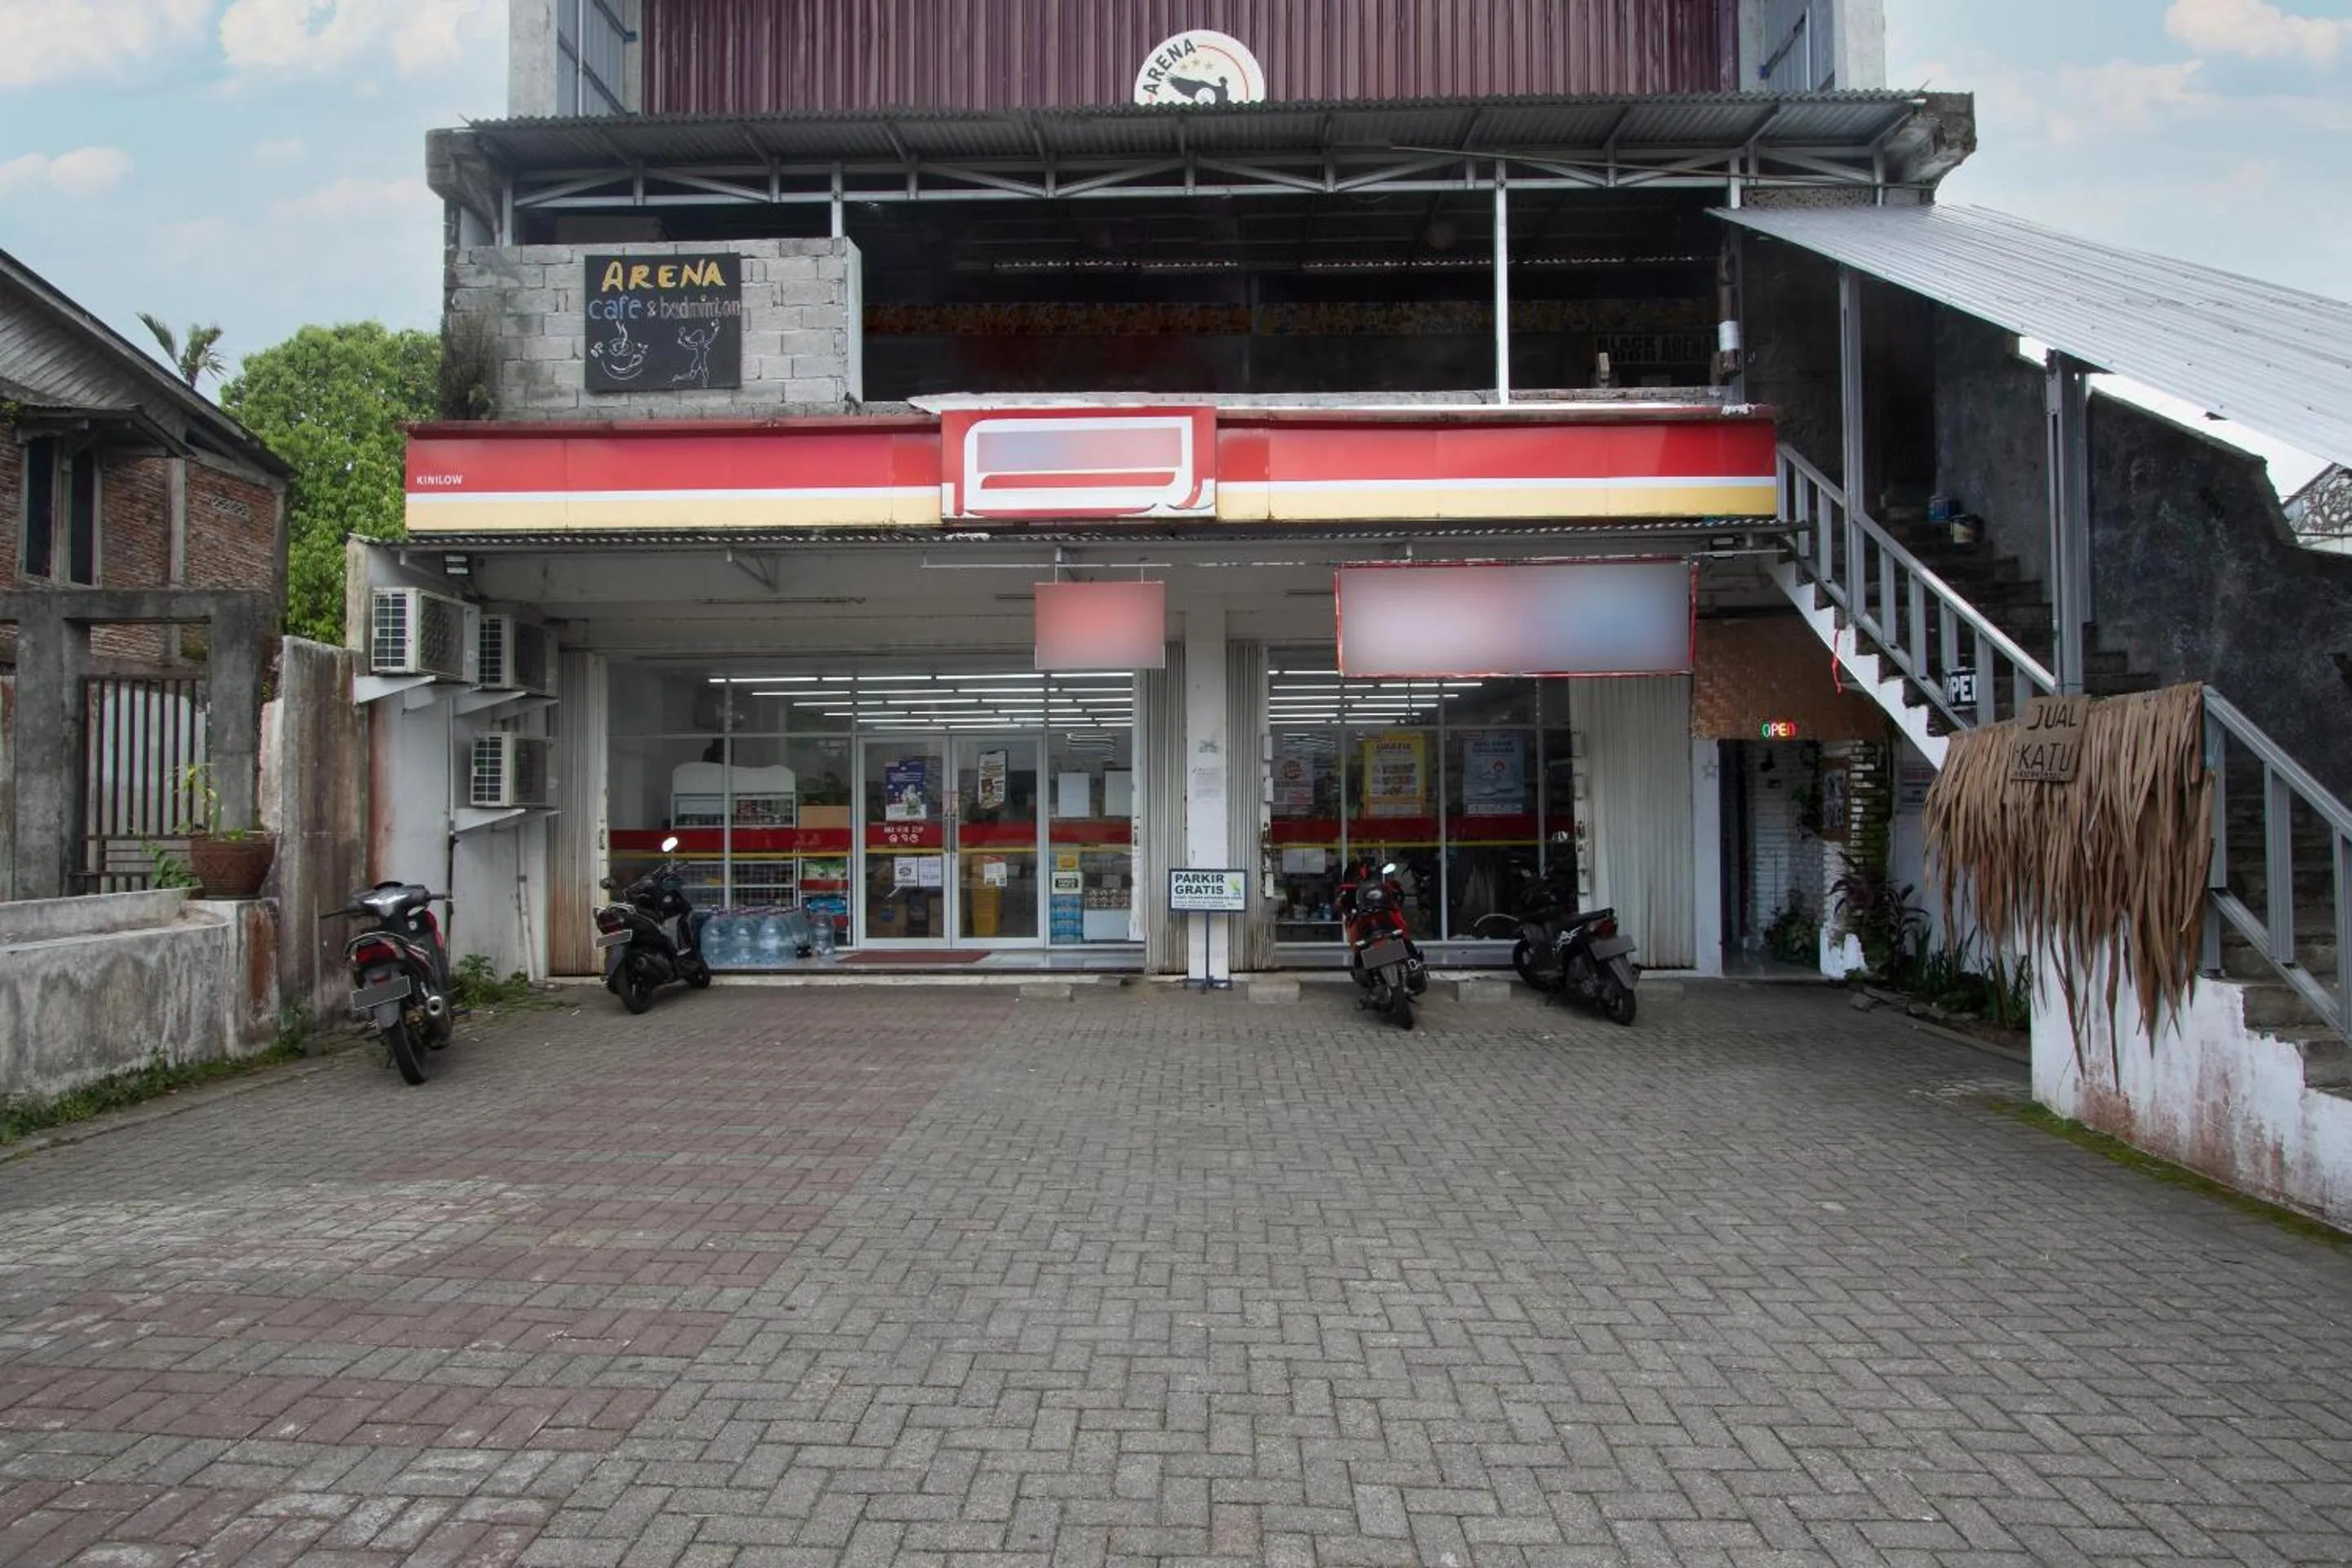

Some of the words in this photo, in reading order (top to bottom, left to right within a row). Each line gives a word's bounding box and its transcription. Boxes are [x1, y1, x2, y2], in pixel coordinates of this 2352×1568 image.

[1143, 38, 1196, 96] ARENA
[601, 259, 727, 292] ARENA
[588, 295, 643, 320] cafe
[647, 301, 657, 317] &
[416, 474, 463, 485] KINILOW
[2026, 704, 2077, 730] JUAL
[1761, 722, 1796, 738] OPEN
[1175, 873, 1225, 884] PARKIR
[1174, 884, 1224, 894] GRATIS
